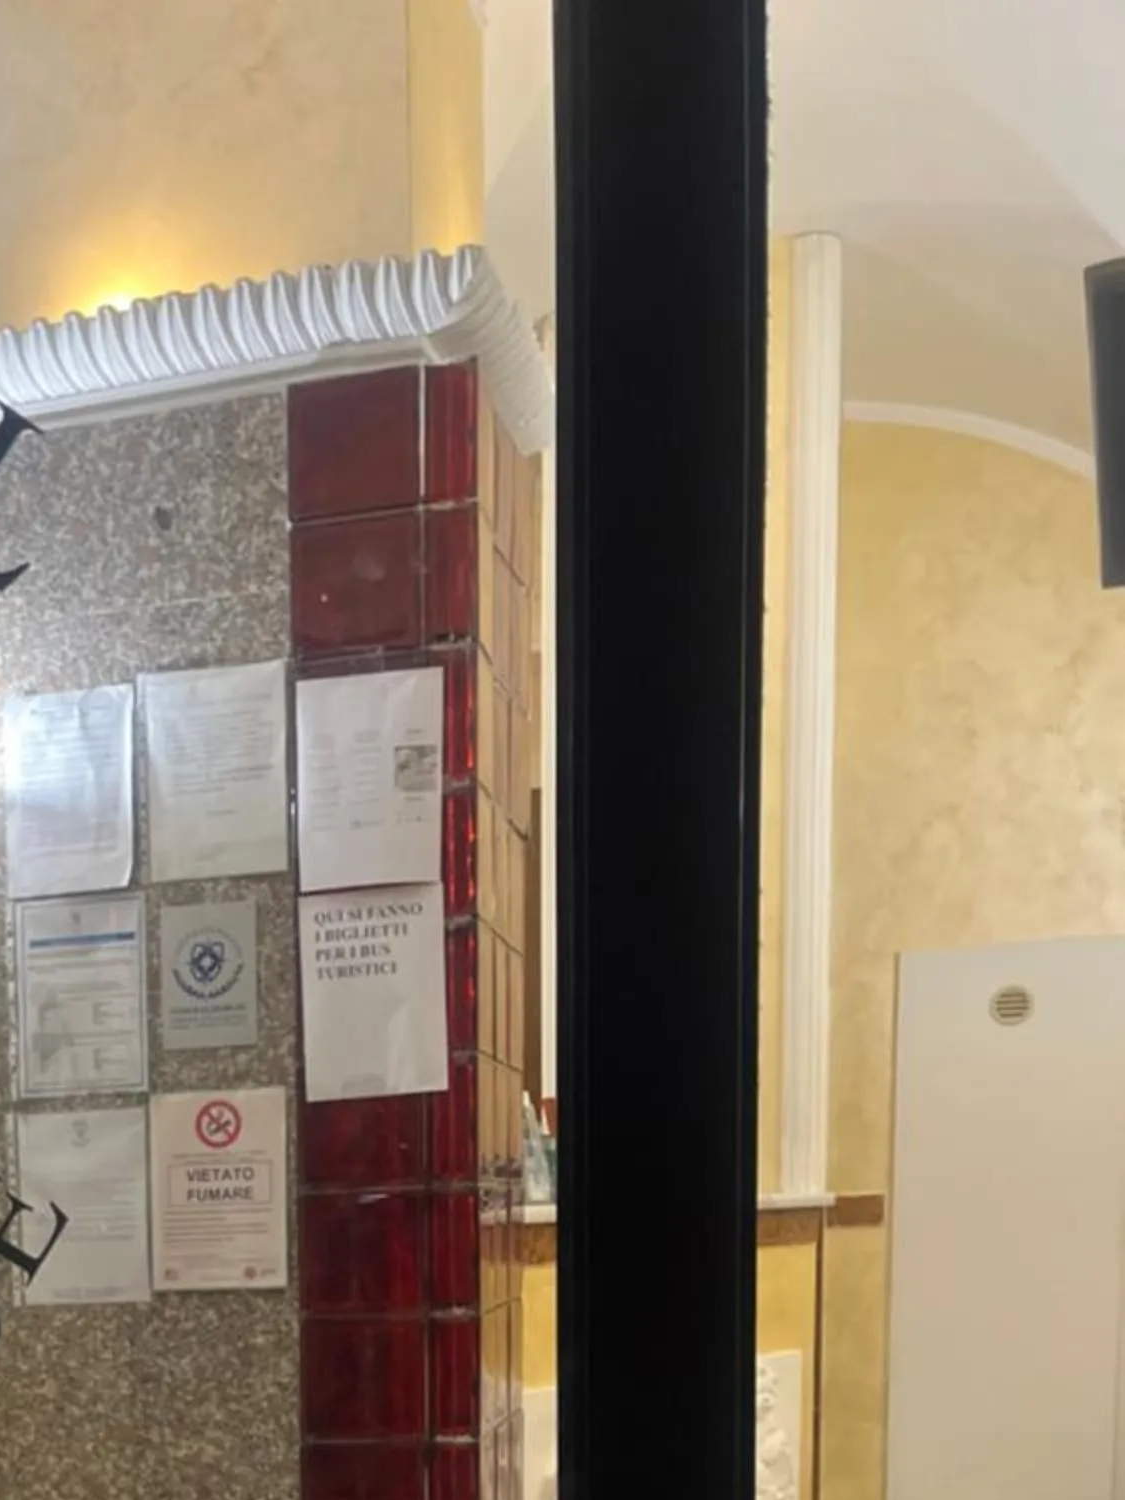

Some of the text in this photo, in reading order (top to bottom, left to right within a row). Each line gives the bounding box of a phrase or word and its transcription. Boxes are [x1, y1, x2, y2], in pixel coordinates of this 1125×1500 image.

[366, 902, 424, 919] FANNO
[324, 922, 408, 942] BIGLIETTI
[315, 946, 346, 962] PER
[360, 942, 392, 958] BUS
[316, 960, 398, 980] TURISTICI
[186, 1166, 255, 1182] VIETATO
[186, 1185, 253, 1201] FUMARE
